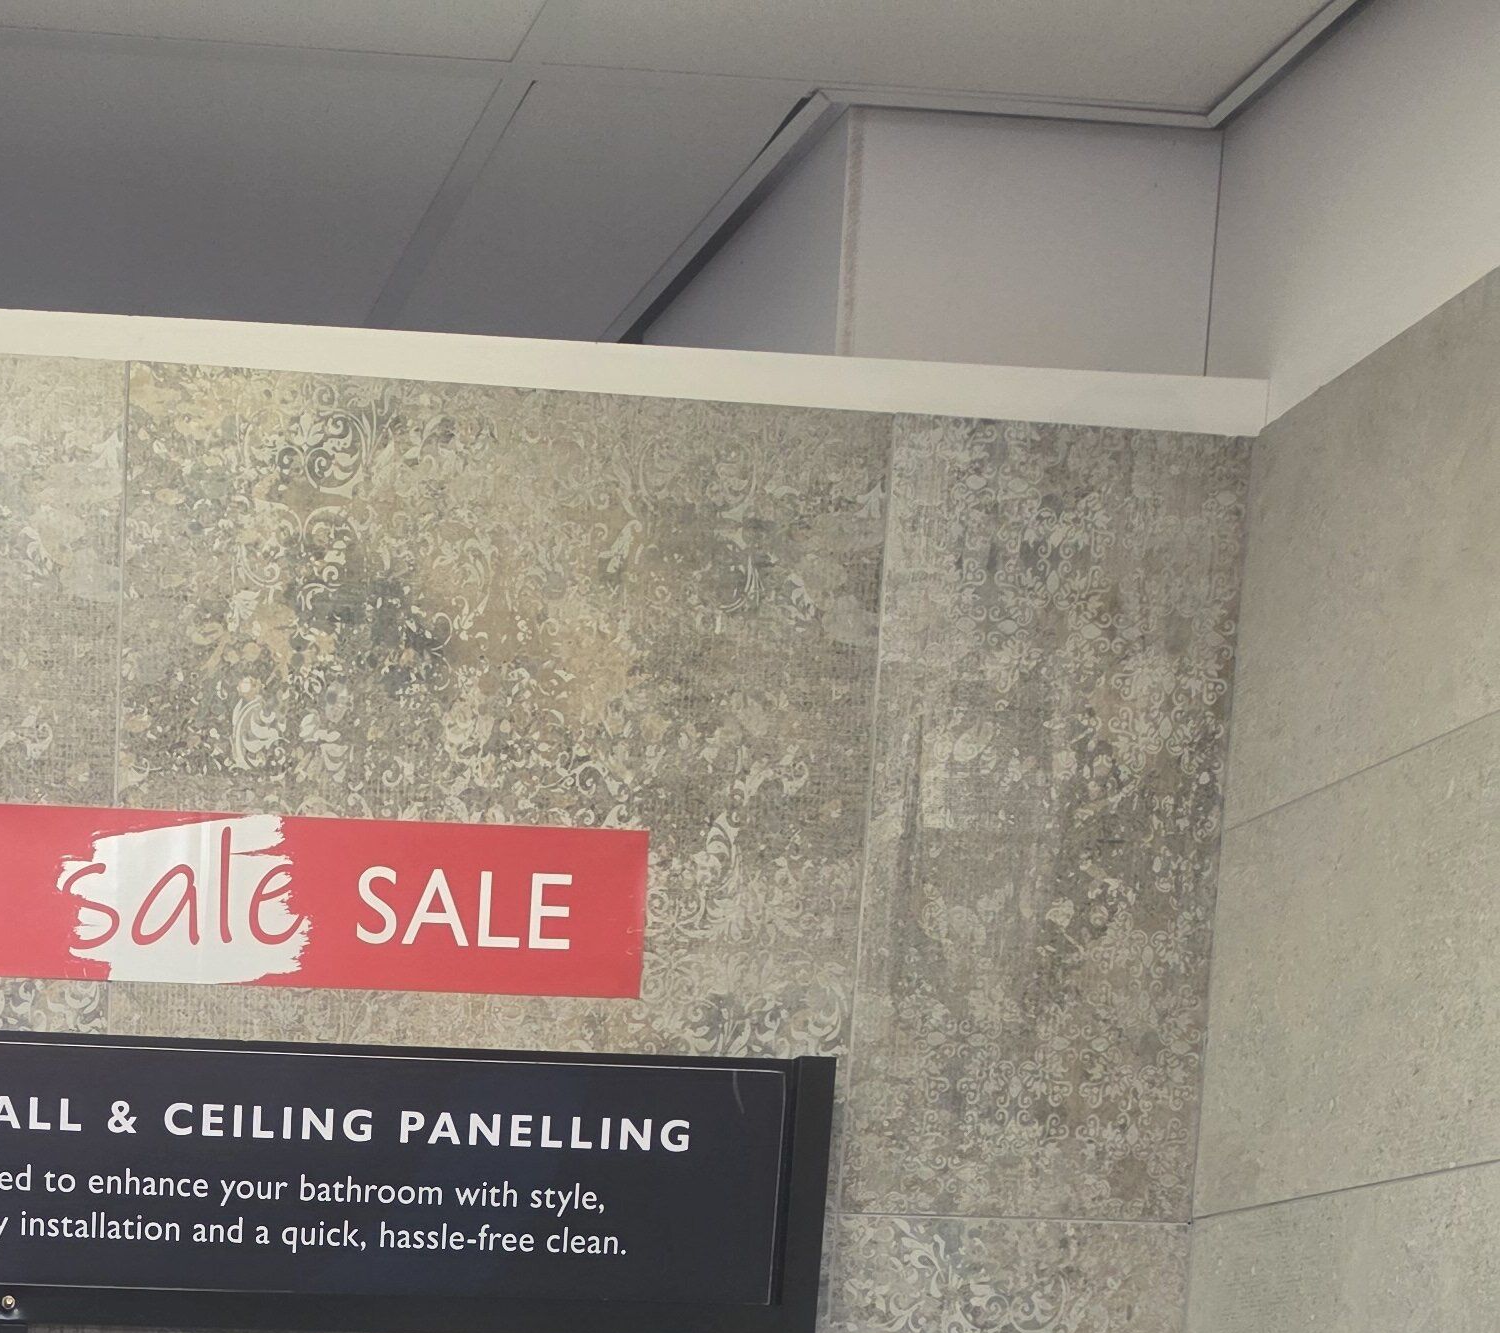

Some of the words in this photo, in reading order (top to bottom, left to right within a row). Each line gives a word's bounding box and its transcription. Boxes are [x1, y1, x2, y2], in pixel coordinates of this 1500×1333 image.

[62, 826, 303, 950] sale
[355, 864, 574, 951] SALE
[106, 1099, 139, 1135] &
[162, 1101, 374, 1143] CEILING
[398, 1109, 691, 1153] PANELLING
[42, 1170, 77, 1194] to
[87, 1166, 210, 1199] enhance
[219, 1178, 290, 1208] your
[298, 1172, 444, 1207] bathroom
[454, 1179, 519, 1209] with
[529, 1182, 607, 1219] style,
[19, 1209, 181, 1243] installation
[191, 1216, 245, 1245] and
[254, 1225, 271, 1246] a
[280, 1218, 368, 1255] quick,
[378, 1220, 536, 1254] hassle-free
[545, 1226, 629, 1257] clean.
